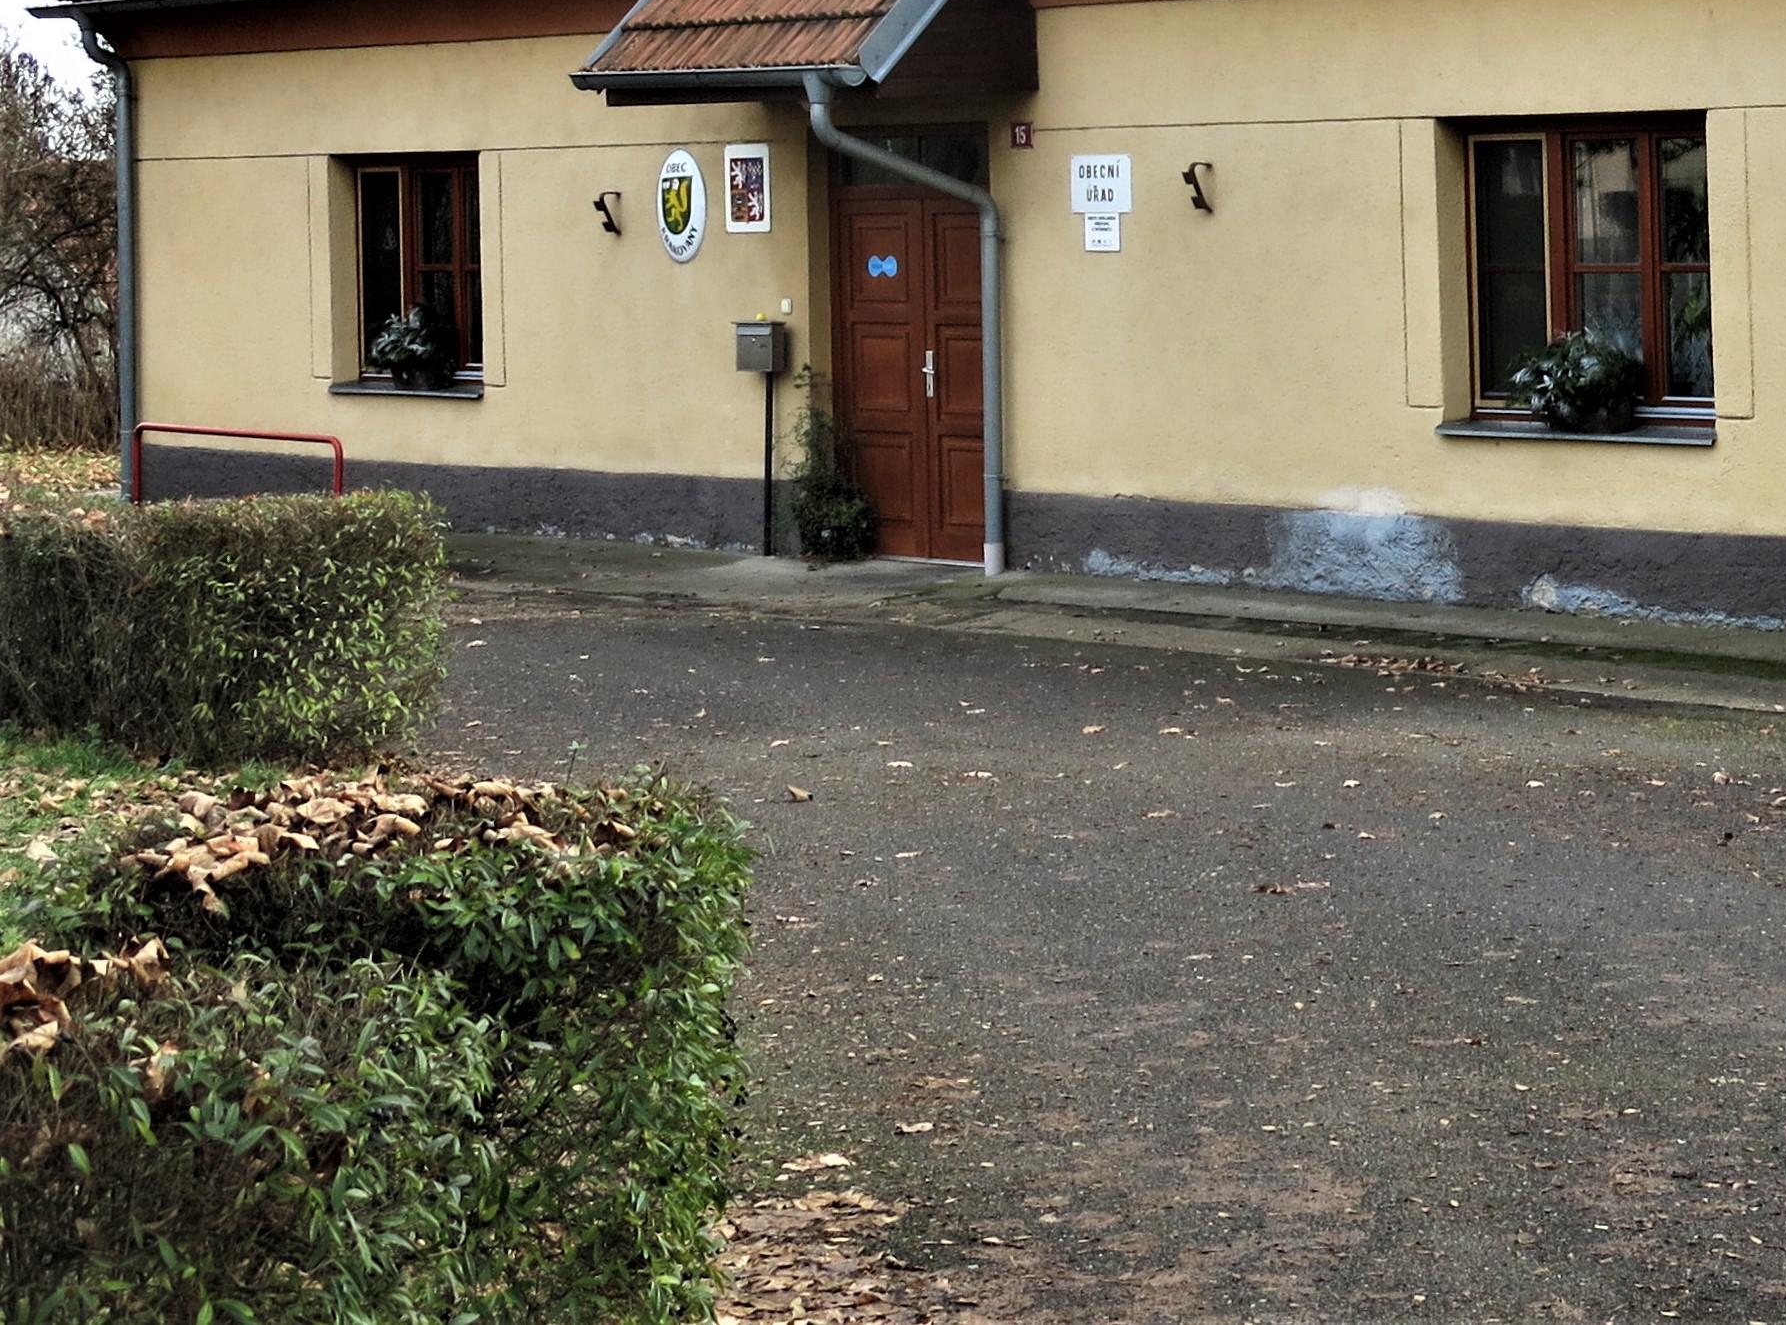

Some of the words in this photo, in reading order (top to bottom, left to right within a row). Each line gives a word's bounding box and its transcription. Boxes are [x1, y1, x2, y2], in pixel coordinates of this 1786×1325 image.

[1015, 125, 1026, 144] 15
[666, 162, 687, 173] OBEC
[1079, 160, 1120, 179] OBECNÍ
[1086, 183, 1114, 202] ÚŘAD
